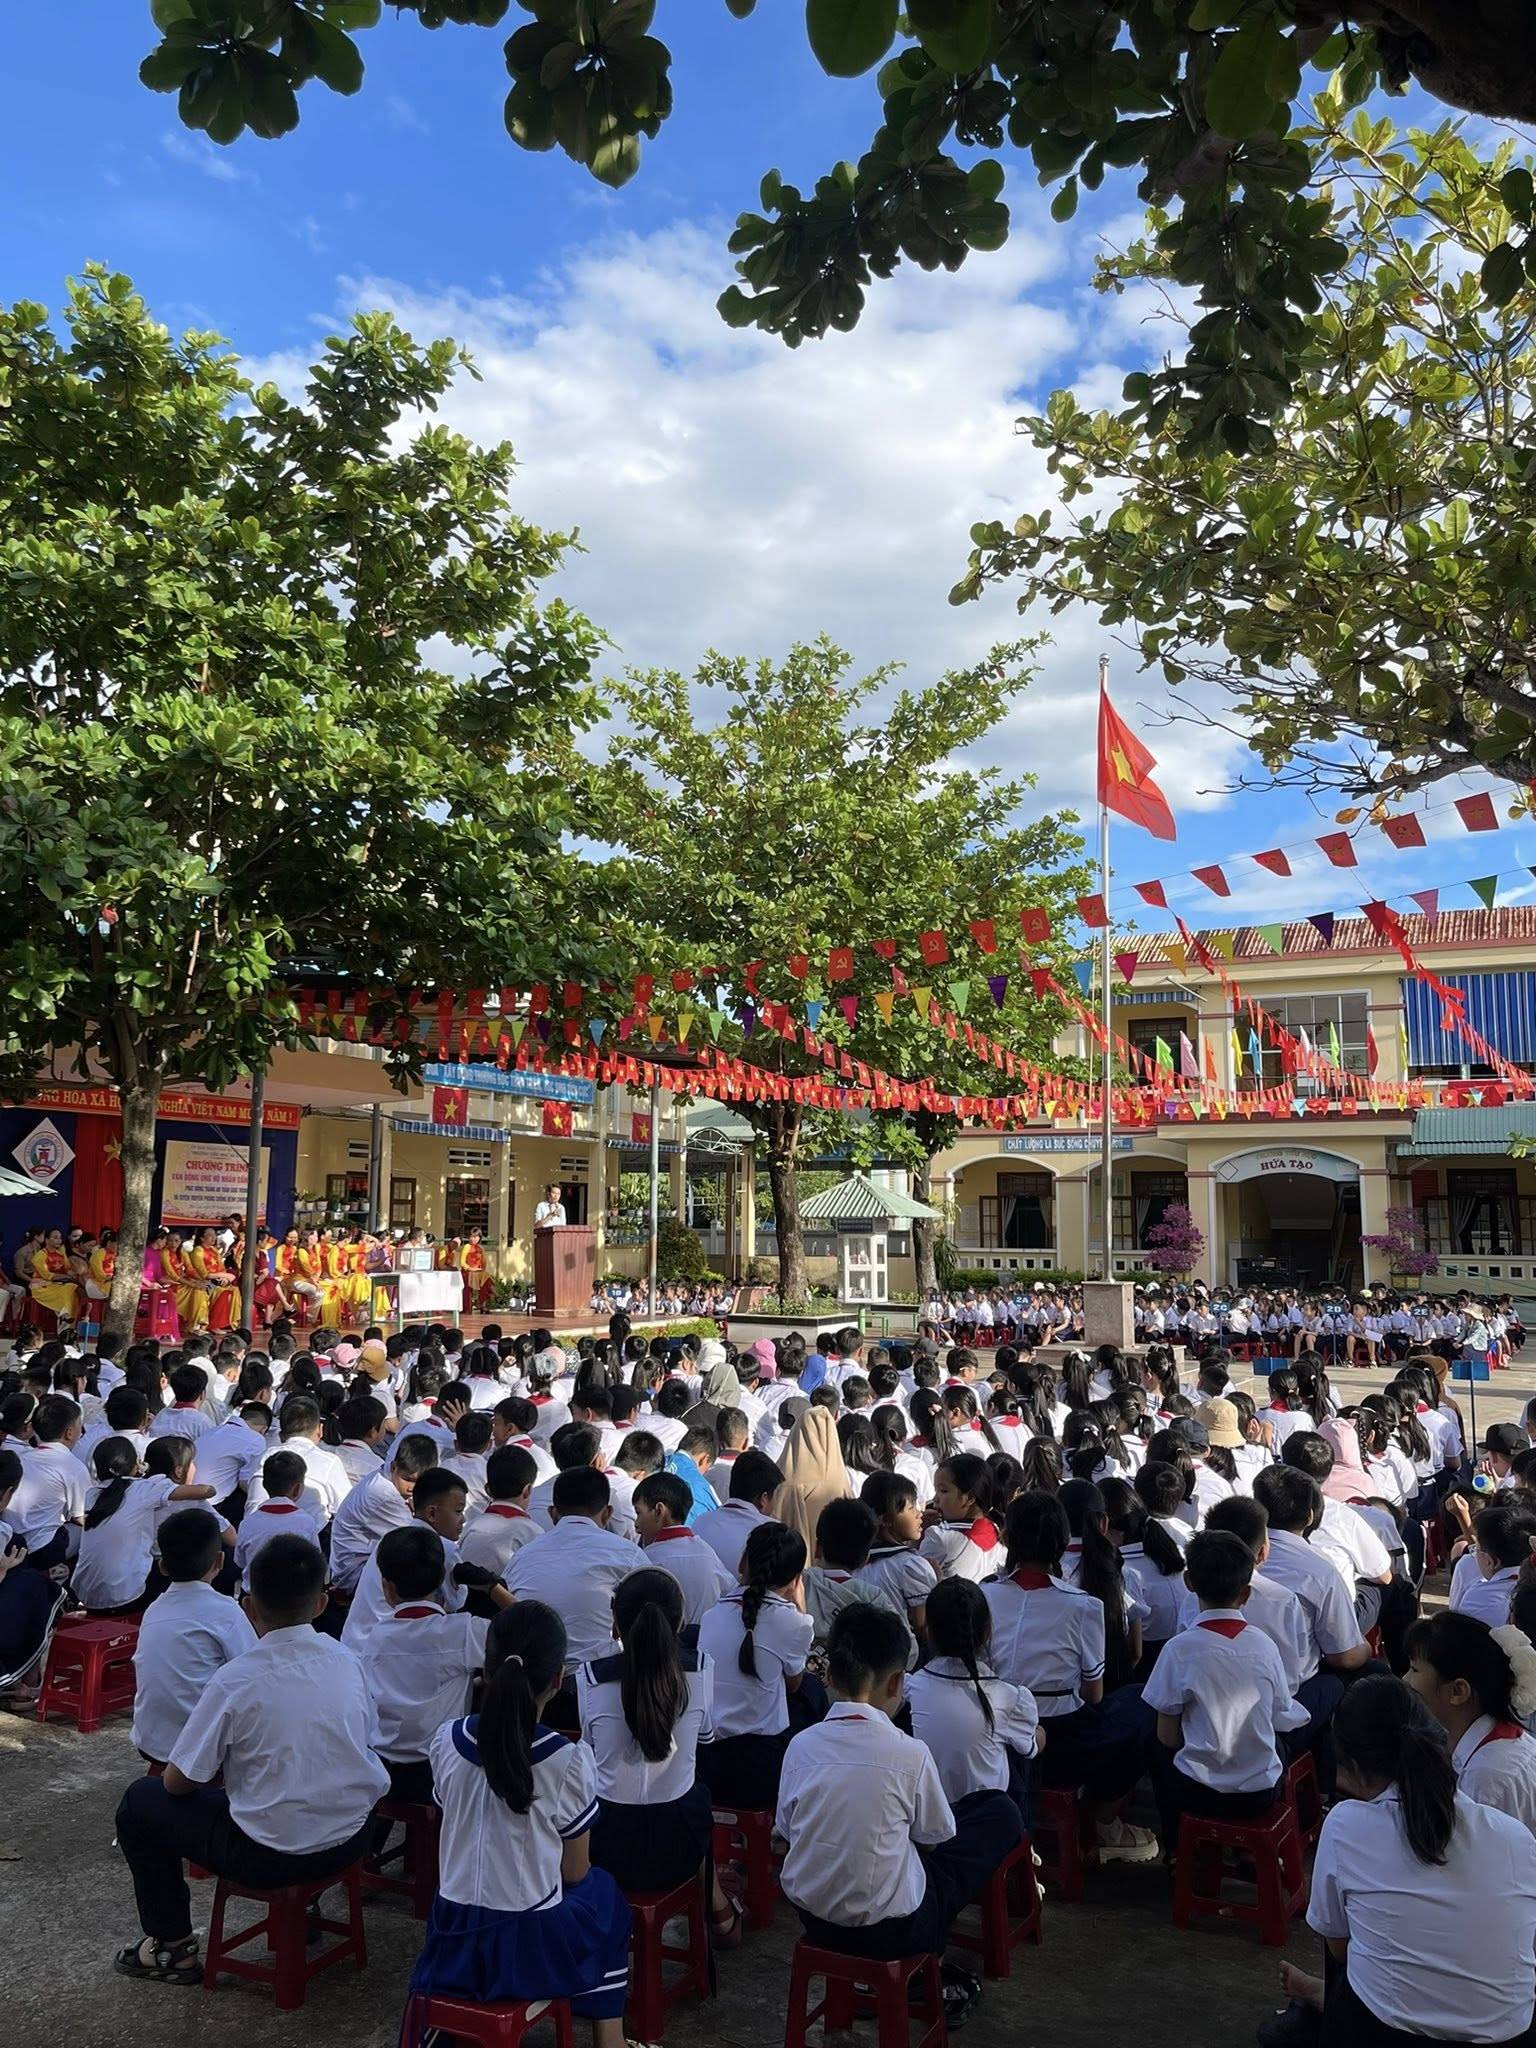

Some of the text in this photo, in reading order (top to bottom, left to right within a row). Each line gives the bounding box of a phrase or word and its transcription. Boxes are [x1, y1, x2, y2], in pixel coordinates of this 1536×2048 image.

[215, 1104, 236, 1118] NAM
[225, 1160, 248, 1173] TRÌN
[1260, 1158, 1313, 1171] HỨA TẠO
[1016, 1296, 1029, 1304] 2A
[1413, 1308, 1429, 1316] 2E
